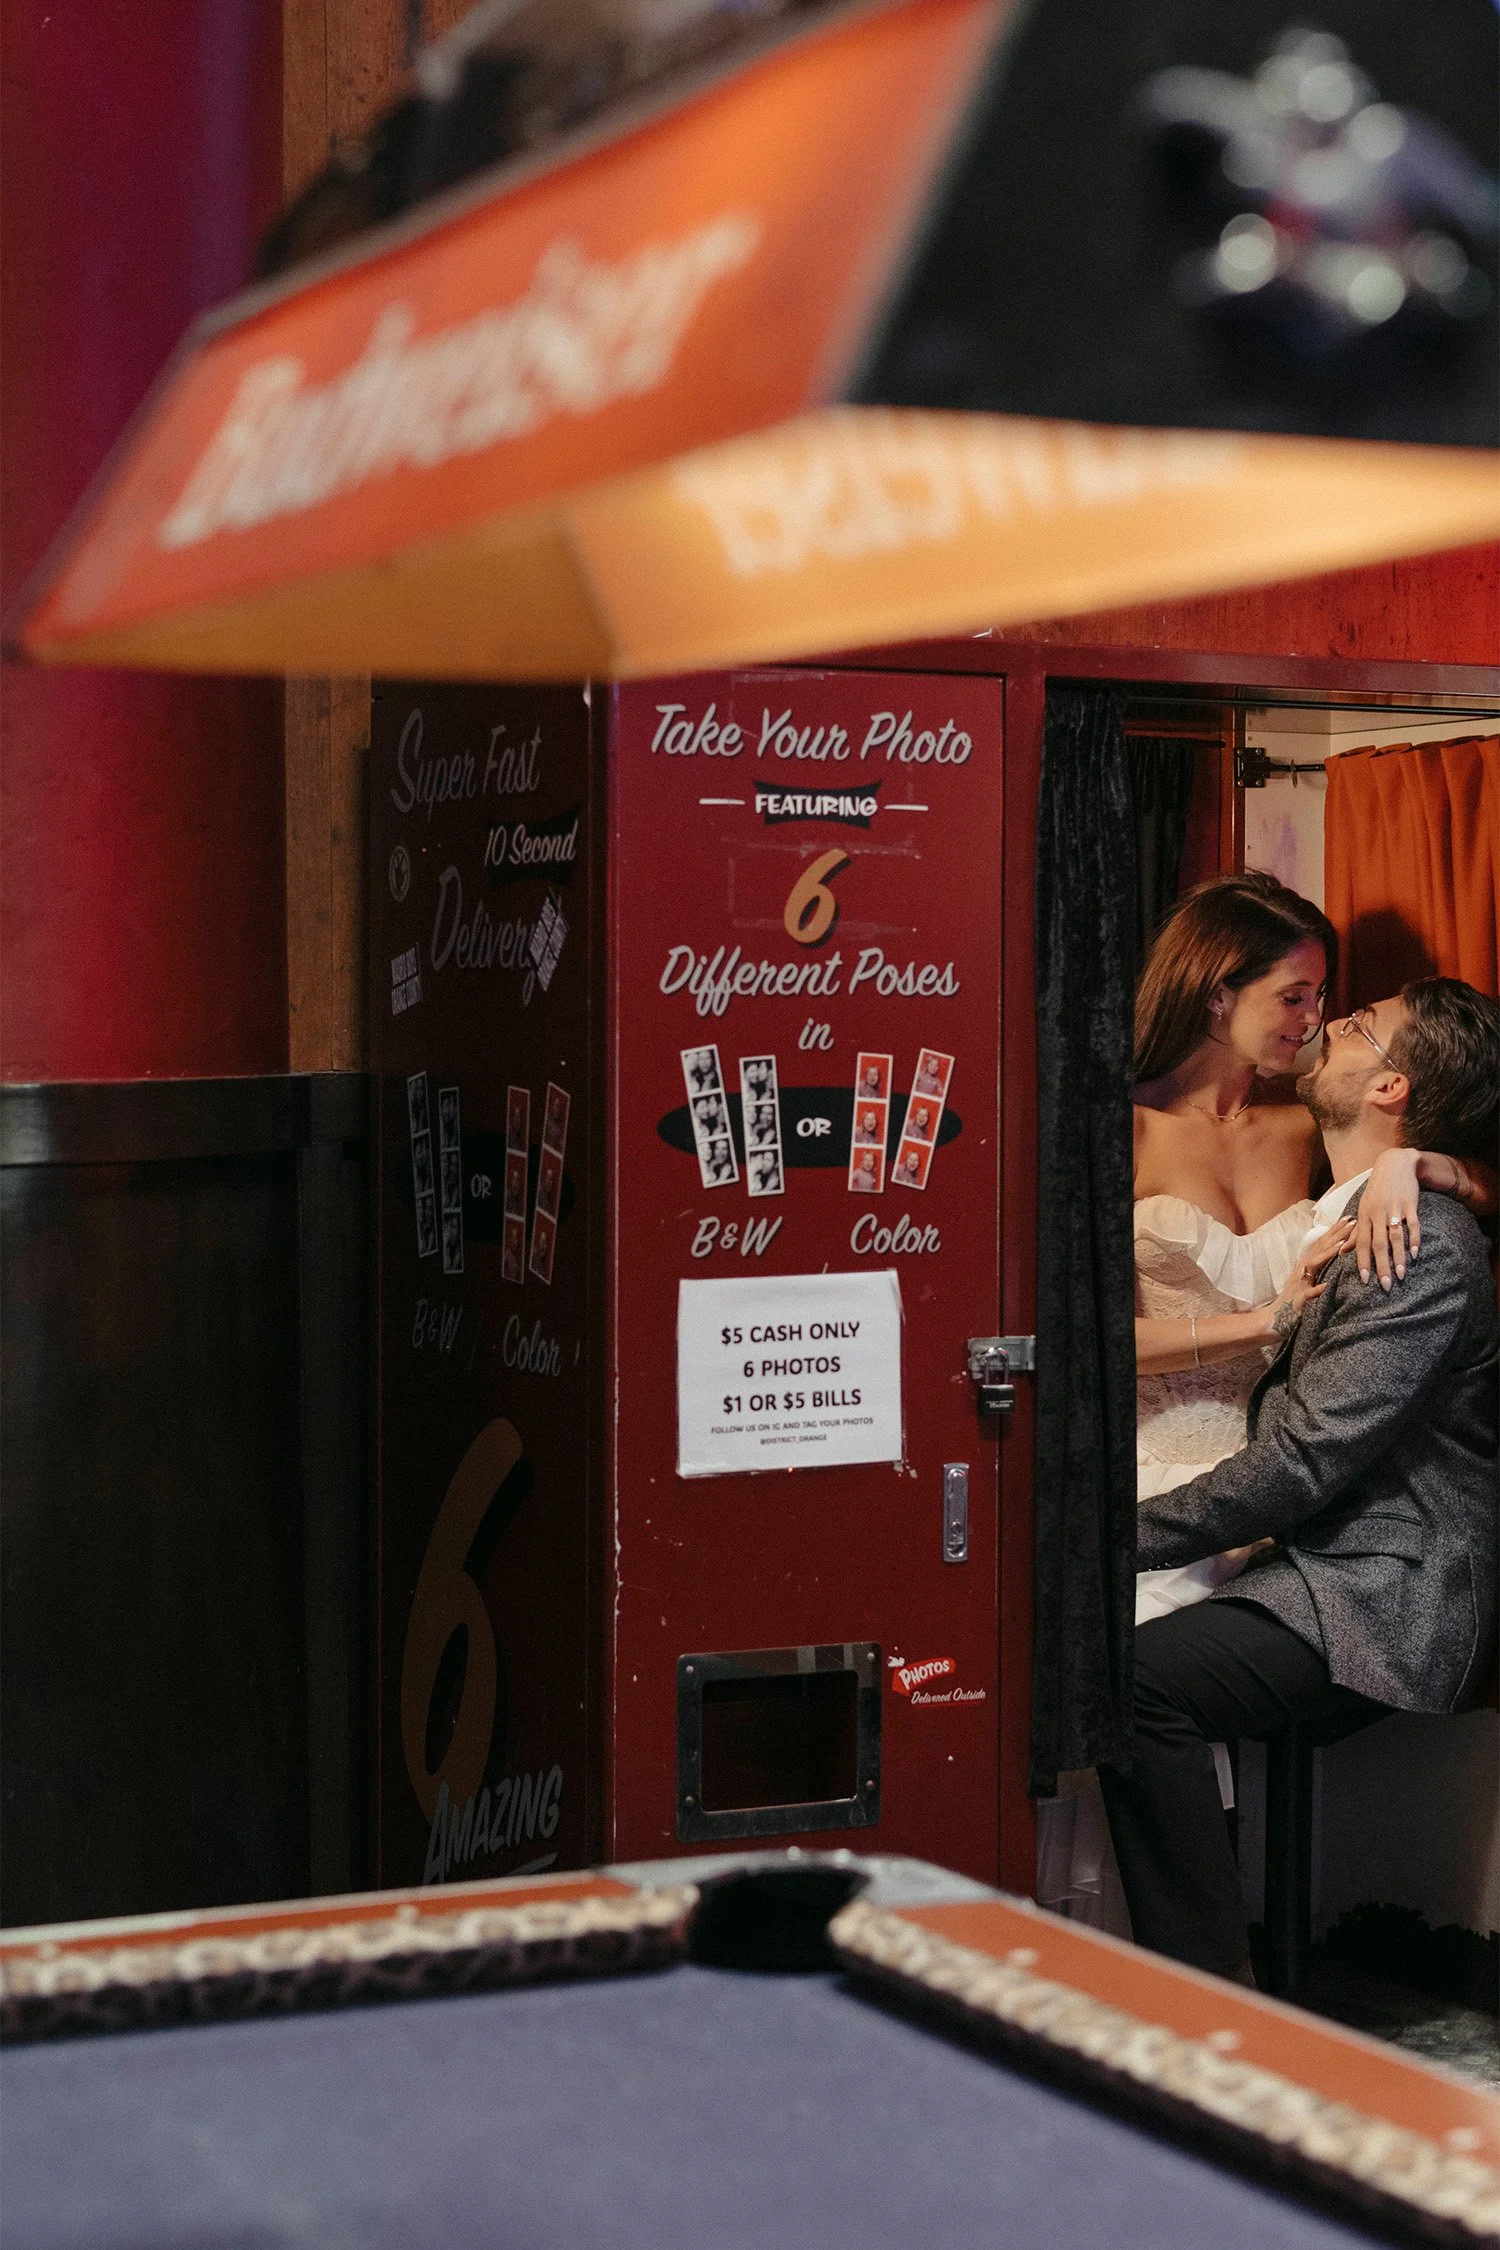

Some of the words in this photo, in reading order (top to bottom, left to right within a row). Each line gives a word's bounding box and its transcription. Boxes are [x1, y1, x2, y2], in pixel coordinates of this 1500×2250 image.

[650, 702, 743, 757] Take
[755, 708, 850, 761] Your
[859, 710, 973, 764] Photo
[391, 707, 477, 823] Super
[482, 724, 542, 795] Fast
[754, 793, 878, 817] FEATURING
[484, 825, 506, 868] 10
[508, 818, 579, 866] Second
[783, 848, 850, 945] 6
[659, 945, 841, 1017] Different
[849, 947, 960, 998] Poses
[798, 1017, 834, 1051] in
[796, 1117, 832, 1138] OR
[470, 1173, 492, 1199] OR
[690, 1215, 784, 1258] B&W
[850, 1213, 941, 1255] Color
[411, 1300, 463, 1352] B&W
[503, 1313, 561, 1377] Color
[721, 1326, 743, 1346] $5
[750, 1324, 802, 1343] CASH
[809, 1321, 860, 1340] ONLY
[743, 1361, 754, 1378] 6
[761, 1356, 841, 1377] PHOTOS
[723, 1395, 742, 1414] $1
[749, 1394, 777, 1412] OR
[783, 1391, 805, 1411] $5
[812, 1388, 862, 1408] BILLS
[711, 1425, 744, 1434] FOLLOW
[745, 1424, 756, 1432] US
[758, 1423, 770, 1431] ON
[783, 1421, 800, 1429] AND
[802, 1420, 818, 1428] TAG
[819, 1418, 841, 1427] YOUR
[843, 1416, 874, 1426] PHOTOS
[400, 1416, 524, 1824] 6
[898, 1660, 950, 1690] PHOTOS
[911, 1690, 951, 1704] Delivered
[952, 1687, 986, 1701] Outside
[423, 1764, 563, 1885] AMAZING
